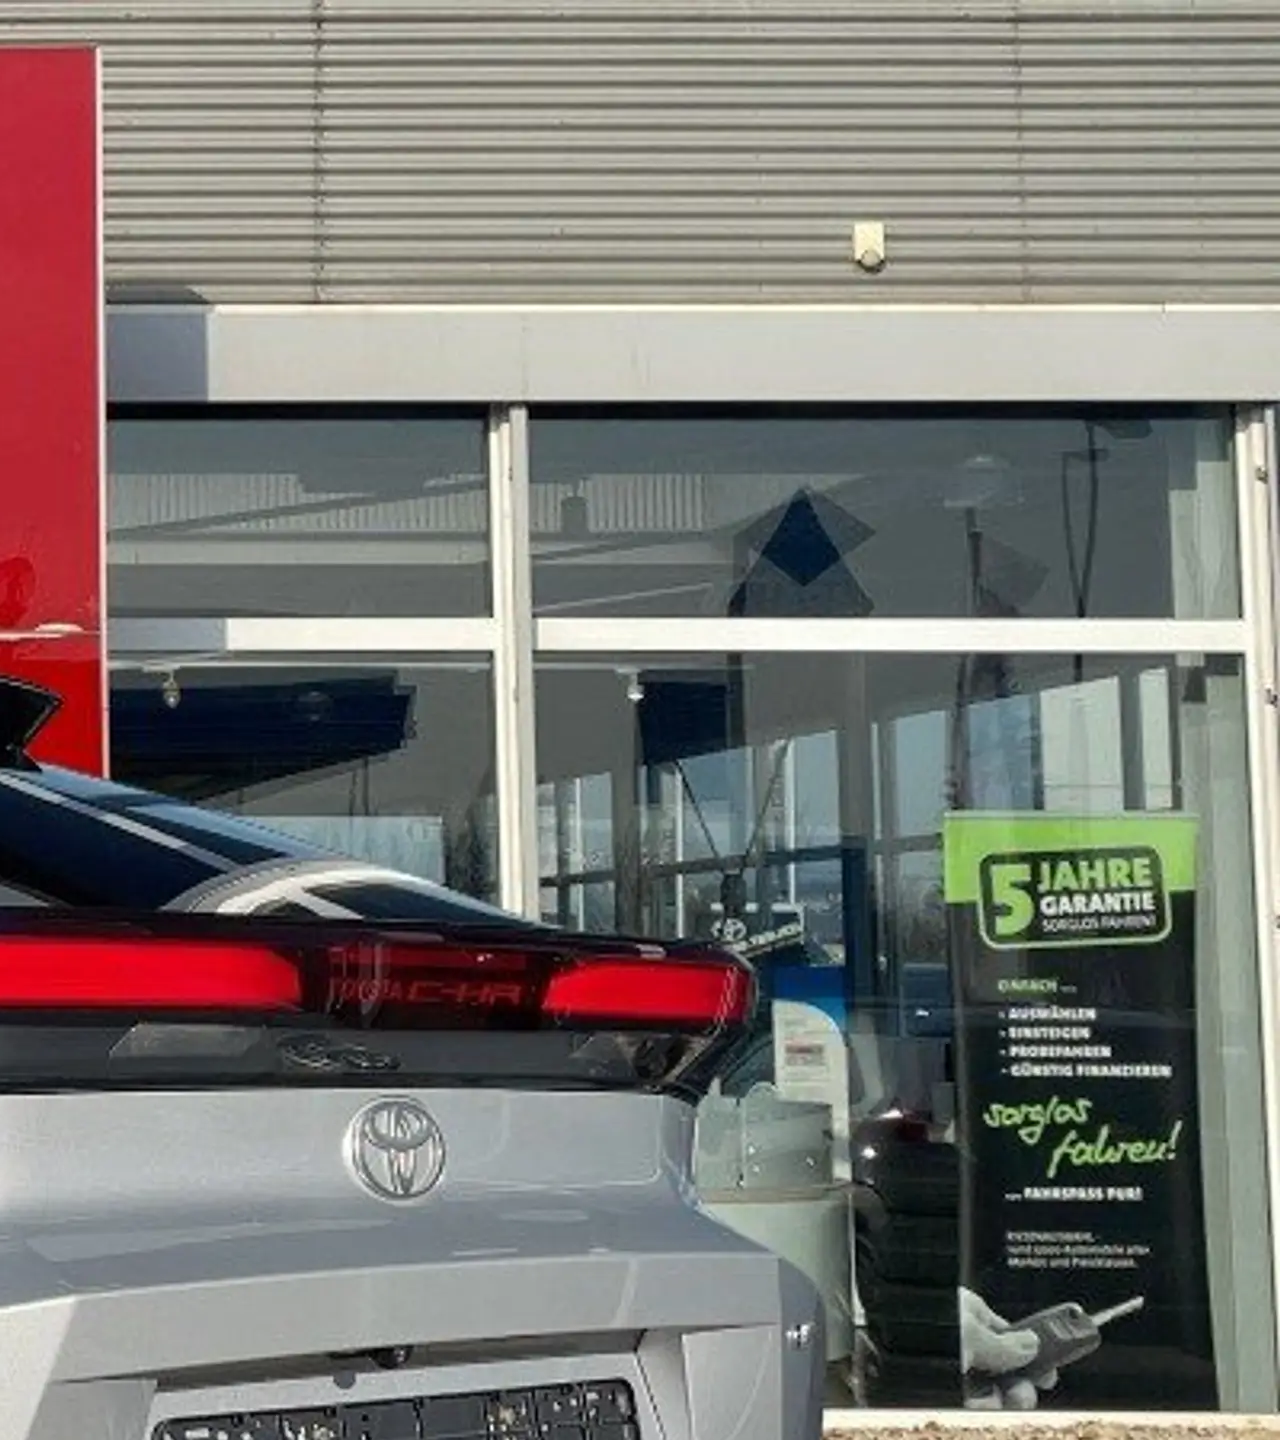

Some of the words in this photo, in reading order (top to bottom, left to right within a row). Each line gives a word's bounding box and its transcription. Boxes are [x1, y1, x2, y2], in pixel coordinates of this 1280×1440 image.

[990, 862, 1035, 936] 5
[1037, 857, 1154, 894] JAHRE
[1039, 891, 1157, 916] GARANTIE
[983, 1095, 1093, 1146] sorglos
[1045, 1119, 1183, 1179] fahren!
